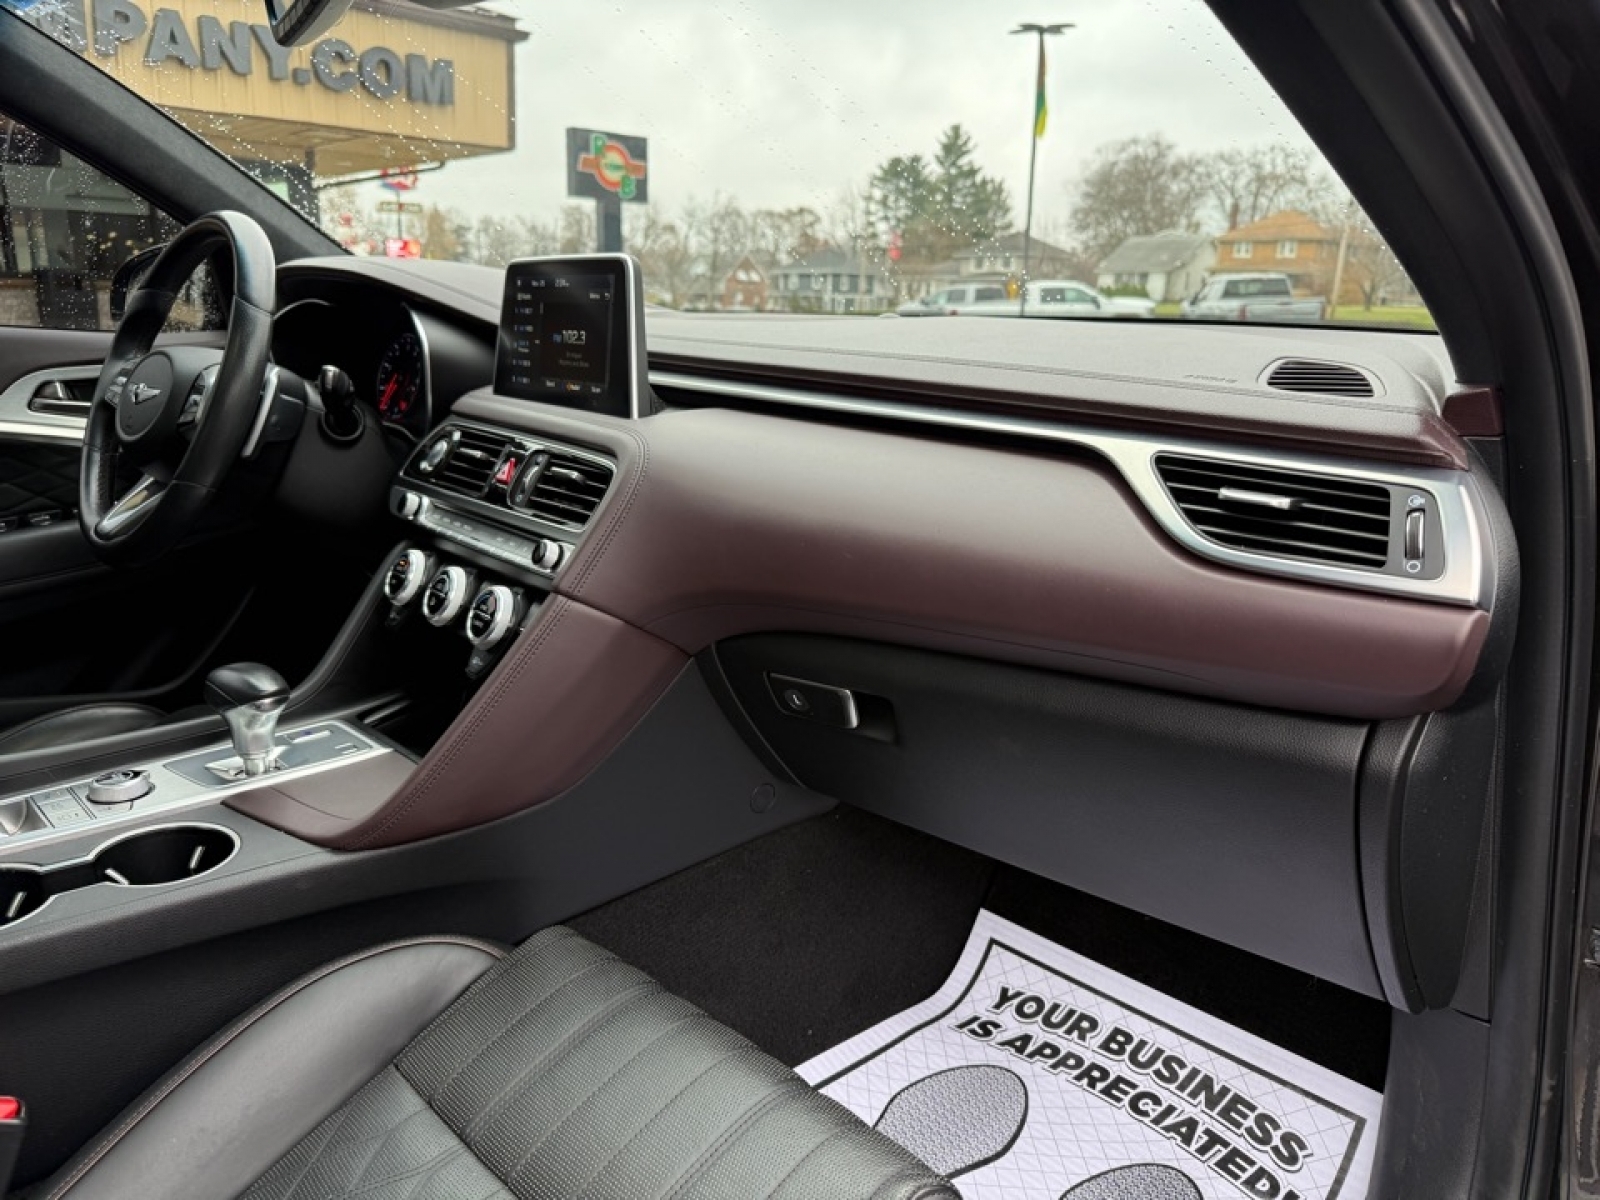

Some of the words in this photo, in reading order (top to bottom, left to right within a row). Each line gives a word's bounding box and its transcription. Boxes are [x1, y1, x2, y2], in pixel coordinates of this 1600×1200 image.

[562, 329, 586, 345] 102.3
[956, 1014, 1000, 1039] IS
[991, 986, 1099, 1042] YOUR
[1097, 1026, 1309, 1169] BUSINESS
